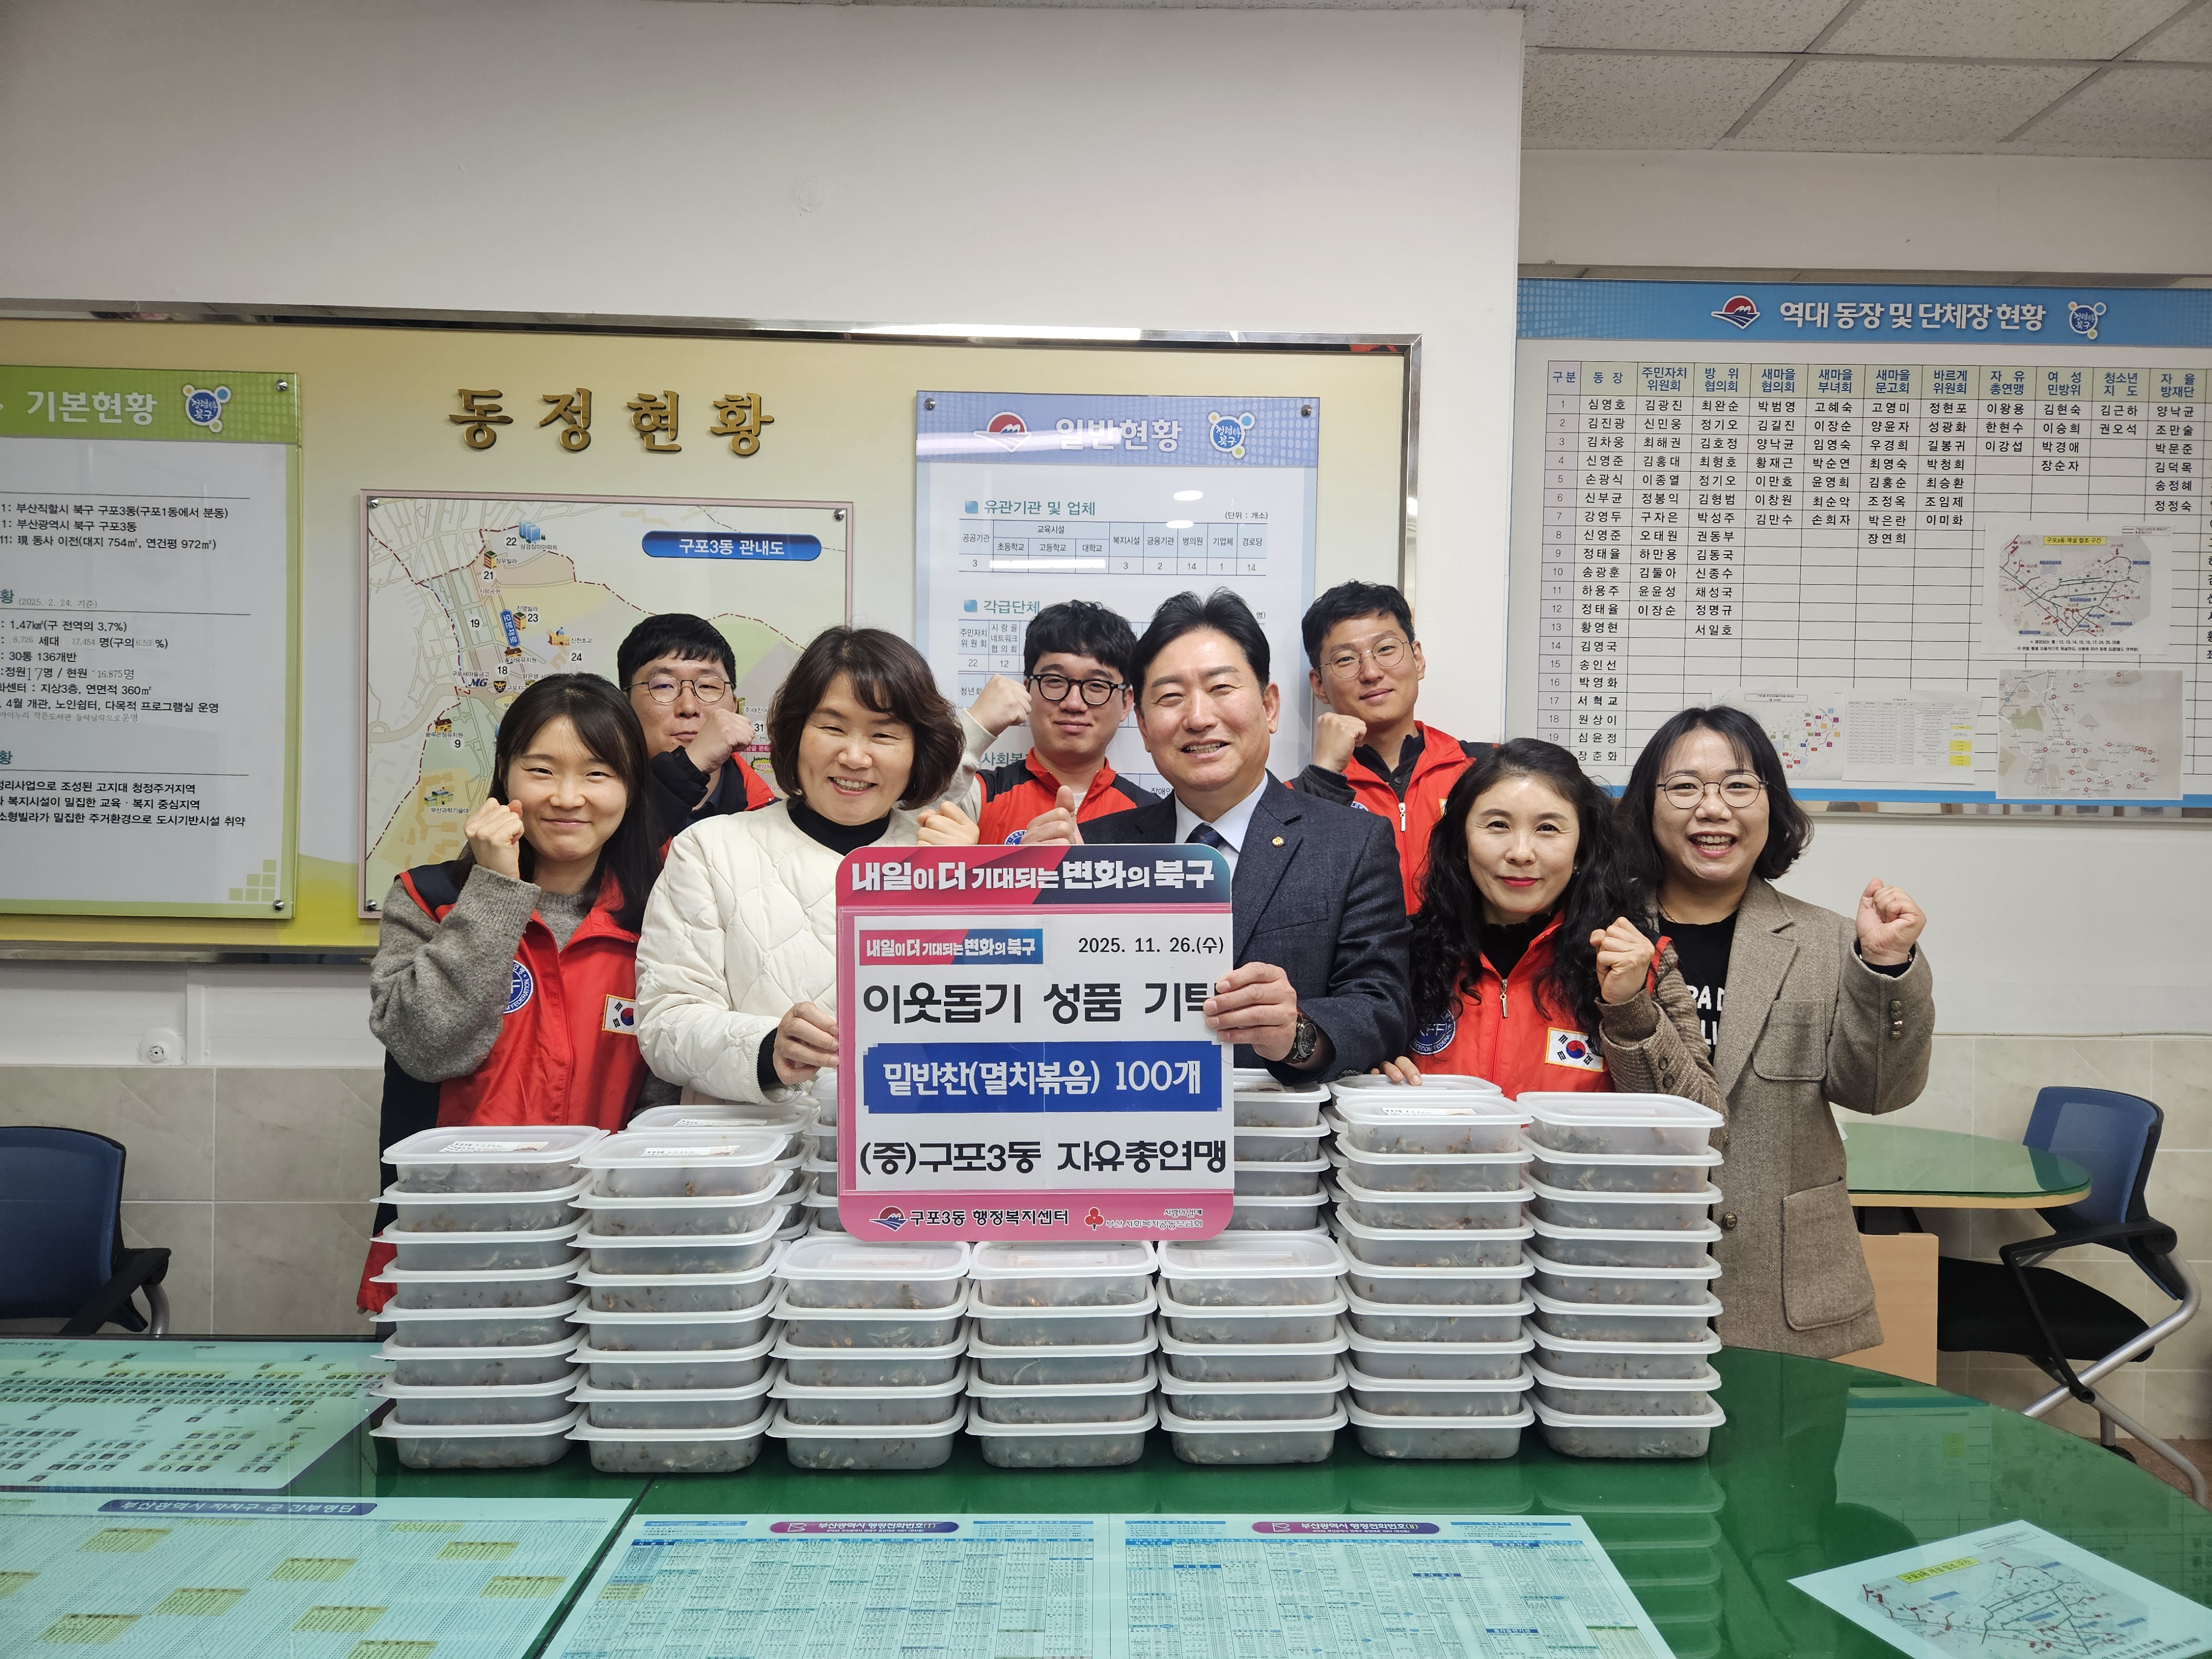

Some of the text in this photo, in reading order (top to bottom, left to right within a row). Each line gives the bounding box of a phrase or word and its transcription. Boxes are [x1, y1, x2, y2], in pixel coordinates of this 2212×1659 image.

[1780, 302, 2047, 331] 역대 동장 및 단체장 현황
[1641, 367, 1687, 379] 주민자치
[1761, 368, 1796, 380] 새마을
[1818, 369, 1853, 381] 새마을
[1875, 369, 1911, 381] 새마을
[1934, 369, 1968, 382] 바르게
[2104, 372, 2138, 384] 청소년
[1647, 379, 1681, 392] 위원회
[1705, 380, 1738, 393] 협의회
[1761, 380, 1794, 393] 협의회
[1818, 382, 1852, 394] 부녀회
[1875, 382, 1910, 394] 문고회
[1933, 382, 1967, 395] 위원회
[1990, 383, 2024, 395] 총연맹
[2048, 382, 2081, 397] 민방위
[2161, 383, 2195, 398] 방재단
[27, 391, 158, 425] 기본현황
[1054, 419, 1182, 452] 일반현황
[16, 503, 69, 515] 부산직할시
[72, 504, 95, 515] 북구
[203, 508, 228, 519] 분동)
[984, 500, 1095, 516] 유관기관 및 업체
[17, 519, 137, 533] 부산광역시 북구 구포3동
[1037, 525, 1065, 534] 교육시설
[32, 535, 54, 546] 동사
[58, 536, 103, 547] 이전(대지
[146, 538, 177, 549] 연건평
[506, 537, 517, 546] 22
[962, 534, 990, 542] 공공기관
[1113, 536, 1140, 545] 복지시설
[1147, 536, 1175, 545] 금융기관
[1182, 537, 1203, 546] 병의원
[1213, 537, 1233, 546] 기업체
[1242, 538, 1262, 546] 경로당
[679, 539, 785, 556] 구포3동 관내도
[997, 542, 1025, 551] 초등학교
[1039, 543, 1066, 552] 고등학교
[1082, 544, 1102, 552] 대학교
[483, 571, 493, 580] 21
[983, 600, 1041, 614] 각급단체
[470, 619, 480, 628] 19
[528, 613, 539, 623] 23
[62, 620, 127, 633] 전역의 3.7%)
[960, 628, 987, 638] 주민자치
[991, 634, 1018, 643] 네트워크
[38, 636, 59, 646] 세대
[9, 651, 77, 662] 30통 136개반
[571, 653, 582, 661] 24
[66, 667, 87, 679] 현원
[497, 666, 508, 675] 18
[468, 678, 488, 687] MG
[86, 684, 117, 695] 연면적
[6, 698, 23, 709] 4월
[105, 700, 137, 711] 다목적
[140, 702, 194, 713] 프로그램실
[197, 702, 218, 713] 운영
[60, 781, 195, 795] 조성된 고지대 청정주거지역
[7, 796, 200, 811] 복지시설이 밀집한 교육 복지 중심지역
[54, 812, 246, 827] 밀집한 주거환경으로 도시기반시설 취약
[971, 868, 1060, 889] 기대되는
[1062, 860, 1150, 889] 변화의
[1154, 860, 1214, 889] 북구
[922, 942, 964, 956] 기대되는
[962, 938, 1006, 956] 변화의
[1007, 938, 1036, 956] 북구
[1078, 936, 1224, 954] 2025. 11. 26.(수)
[863, 982, 1021, 1024] 이웃돕기
[1044, 983, 1122, 1025] 성품
[883, 1058, 1201, 1097] 밑반찬(멸치볶음) 100개
[1057, 1140, 1226, 1173] 자유총연맹
[910, 1210, 1068, 1226] 구포3동 행정복지센터
